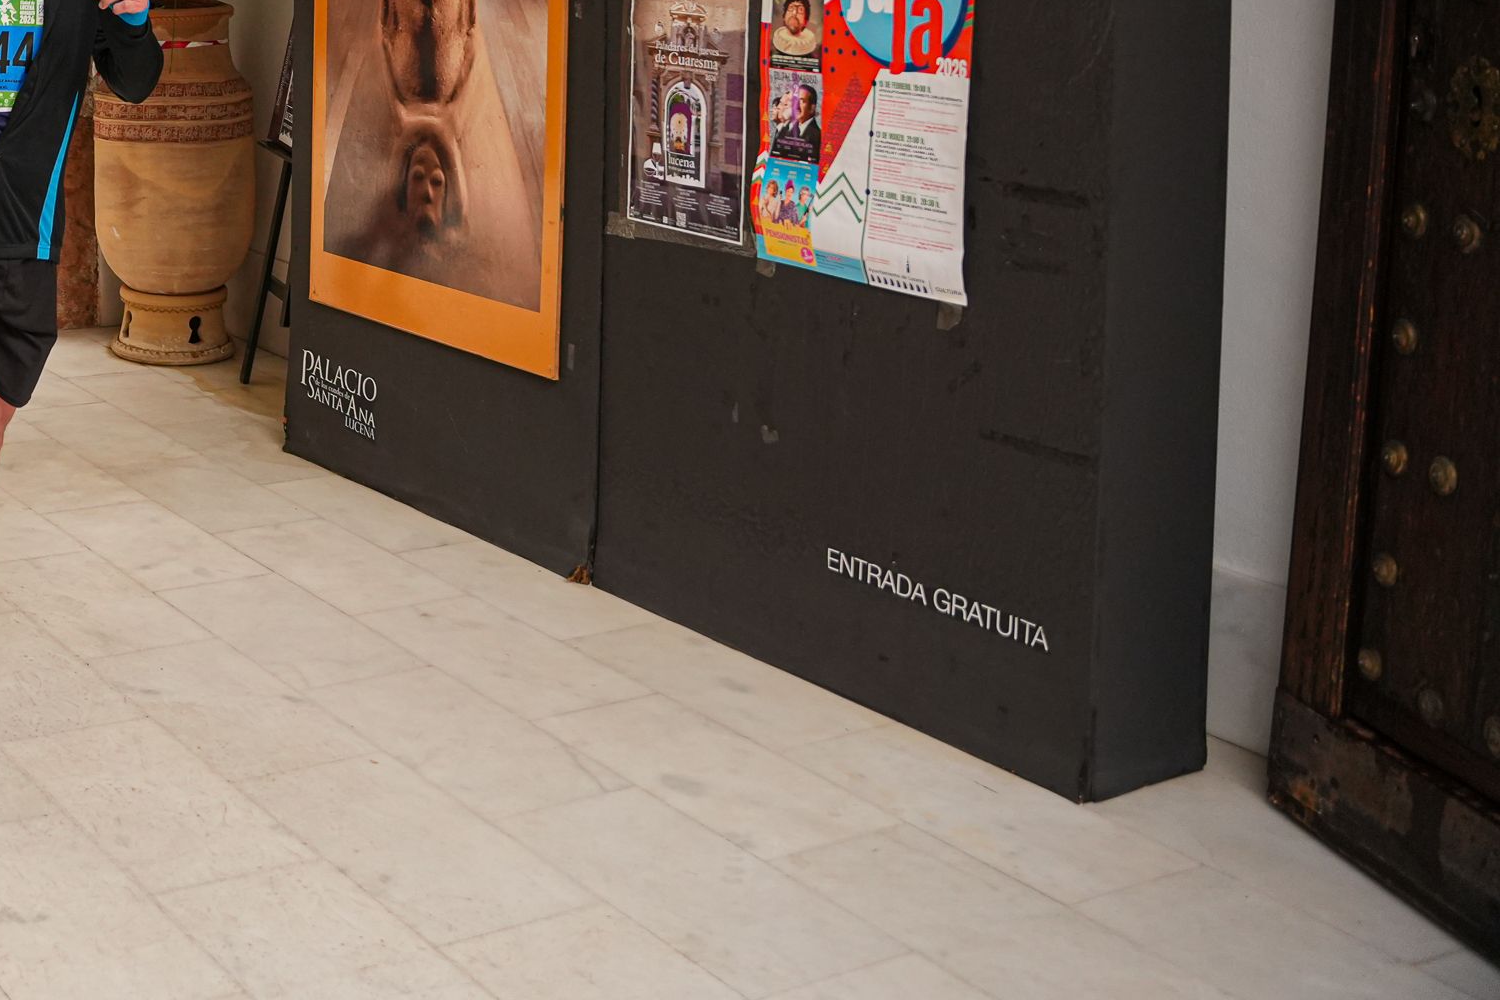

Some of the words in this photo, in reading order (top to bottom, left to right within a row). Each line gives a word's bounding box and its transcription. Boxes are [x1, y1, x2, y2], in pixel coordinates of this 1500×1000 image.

[19, 15, 35, 24] 2026
[654, 50, 666, 64] de
[668, 51, 718, 70] Cuaresma
[936, 57, 967, 78] 2026
[668, 152, 695, 169] lucena
[300, 348, 377, 402] PALACIO
[315, 378, 320, 386] de
[328, 386, 344, 397] condes
[307, 374, 344, 414] SANTA
[346, 394, 376, 429] ANA
[344, 415, 375, 440] LUCENA
[827, 547, 927, 606] ENTRADA
[933, 588, 1049, 652] GRATUITA
